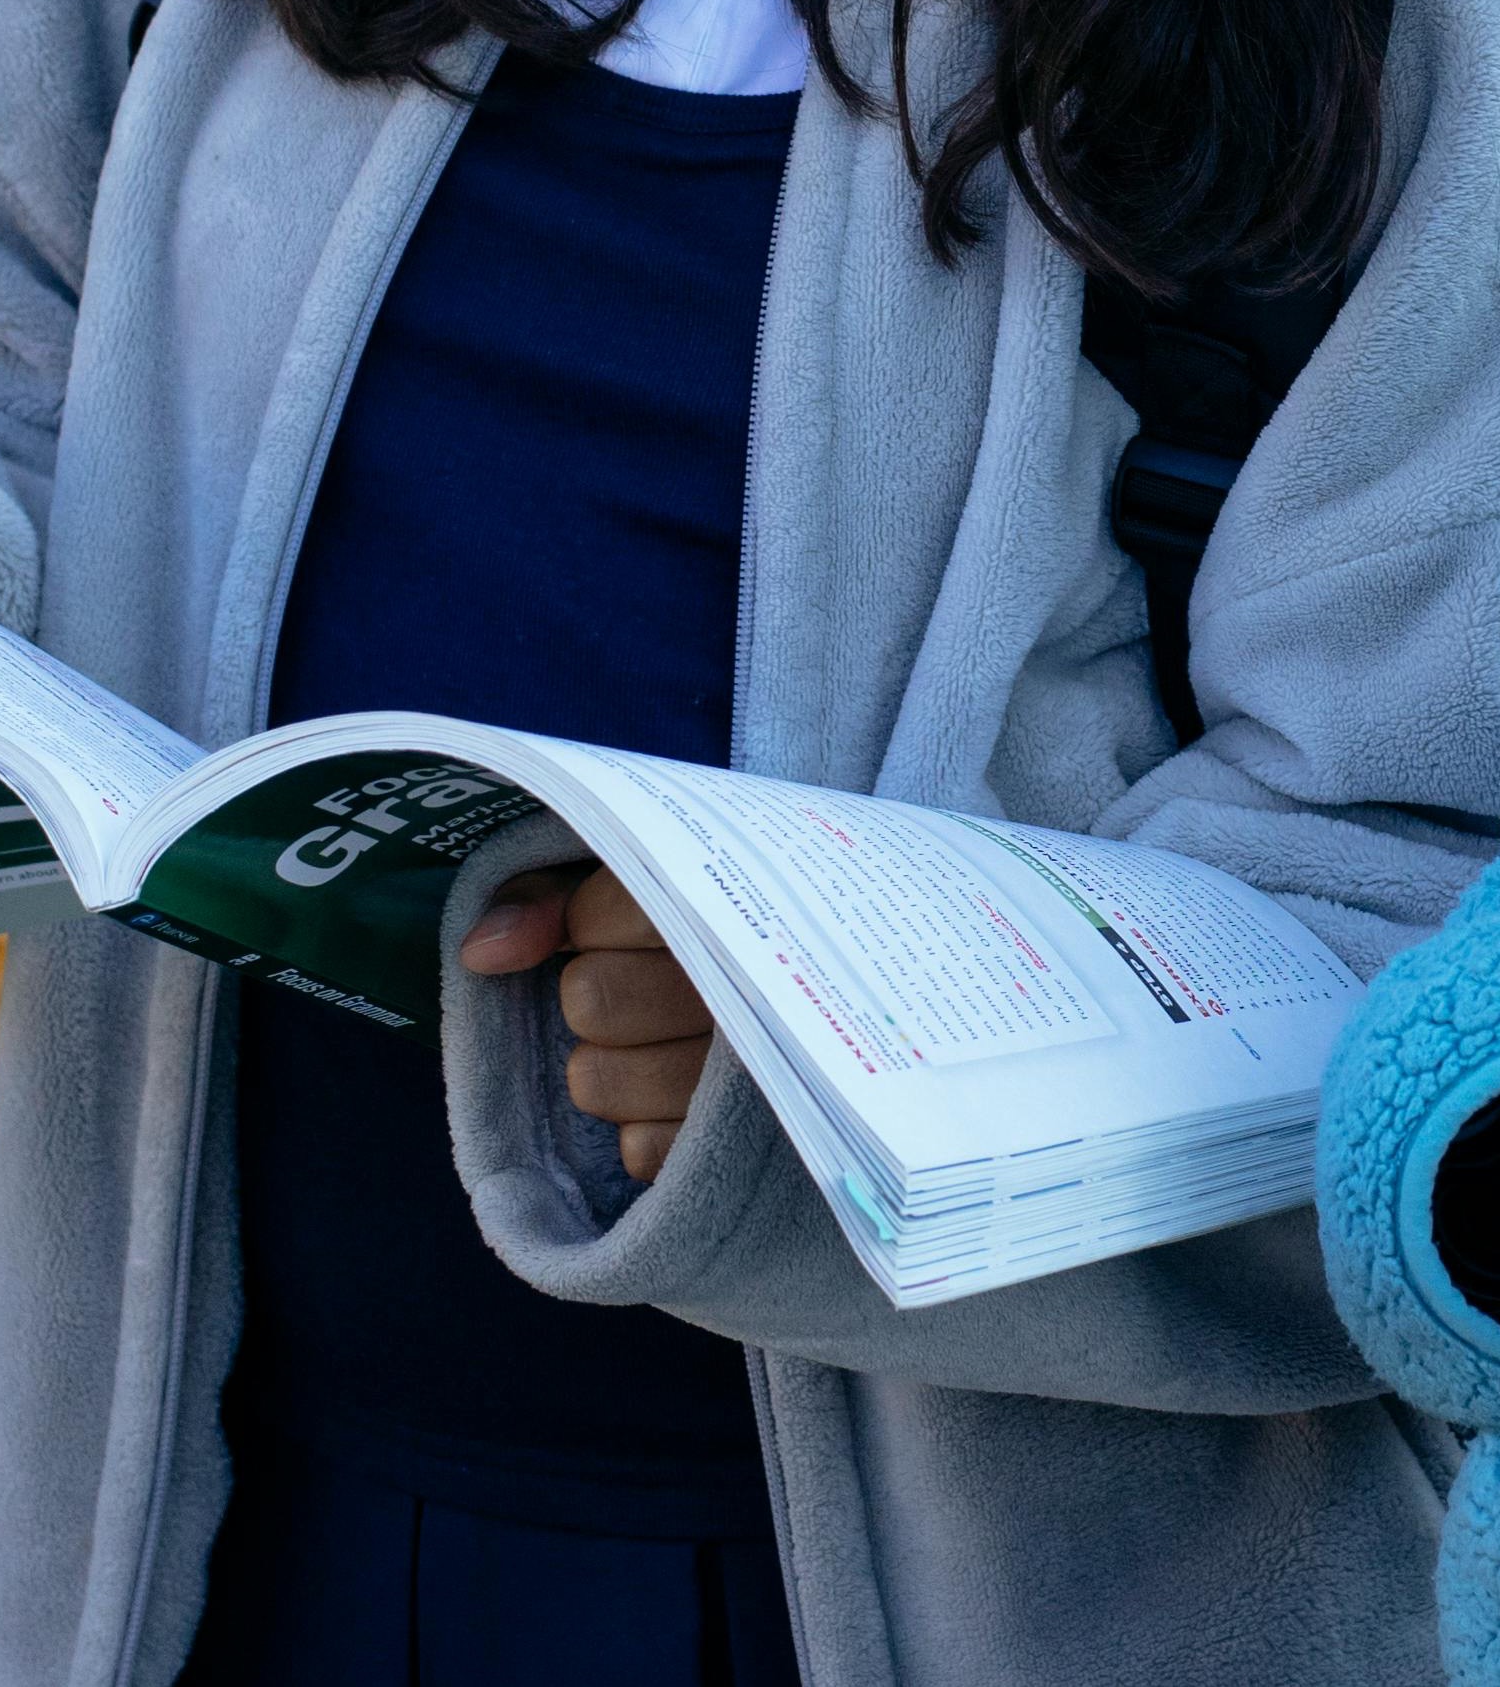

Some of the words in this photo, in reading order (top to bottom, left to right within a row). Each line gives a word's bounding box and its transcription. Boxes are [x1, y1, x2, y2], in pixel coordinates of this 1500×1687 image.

[1008, 832, 1105, 901] LISTENING
[700, 862, 770, 939] EDITING
[1113, 940, 1131, 955] 4
[1127, 926, 1212, 1018] EXERCISE
[267, 968, 319, 993] Focus
[314, 985, 348, 1002] on
[336, 995, 416, 1028] Grammar
[866, 958, 917, 1011] birthday
[1127, 956, 1175, 1007] STEP
[788, 972, 878, 1073] EXERCISE
[938, 996, 981, 1039] believe
[971, 984, 1018, 1033] listened
[997, 990, 1036, 1030] school
